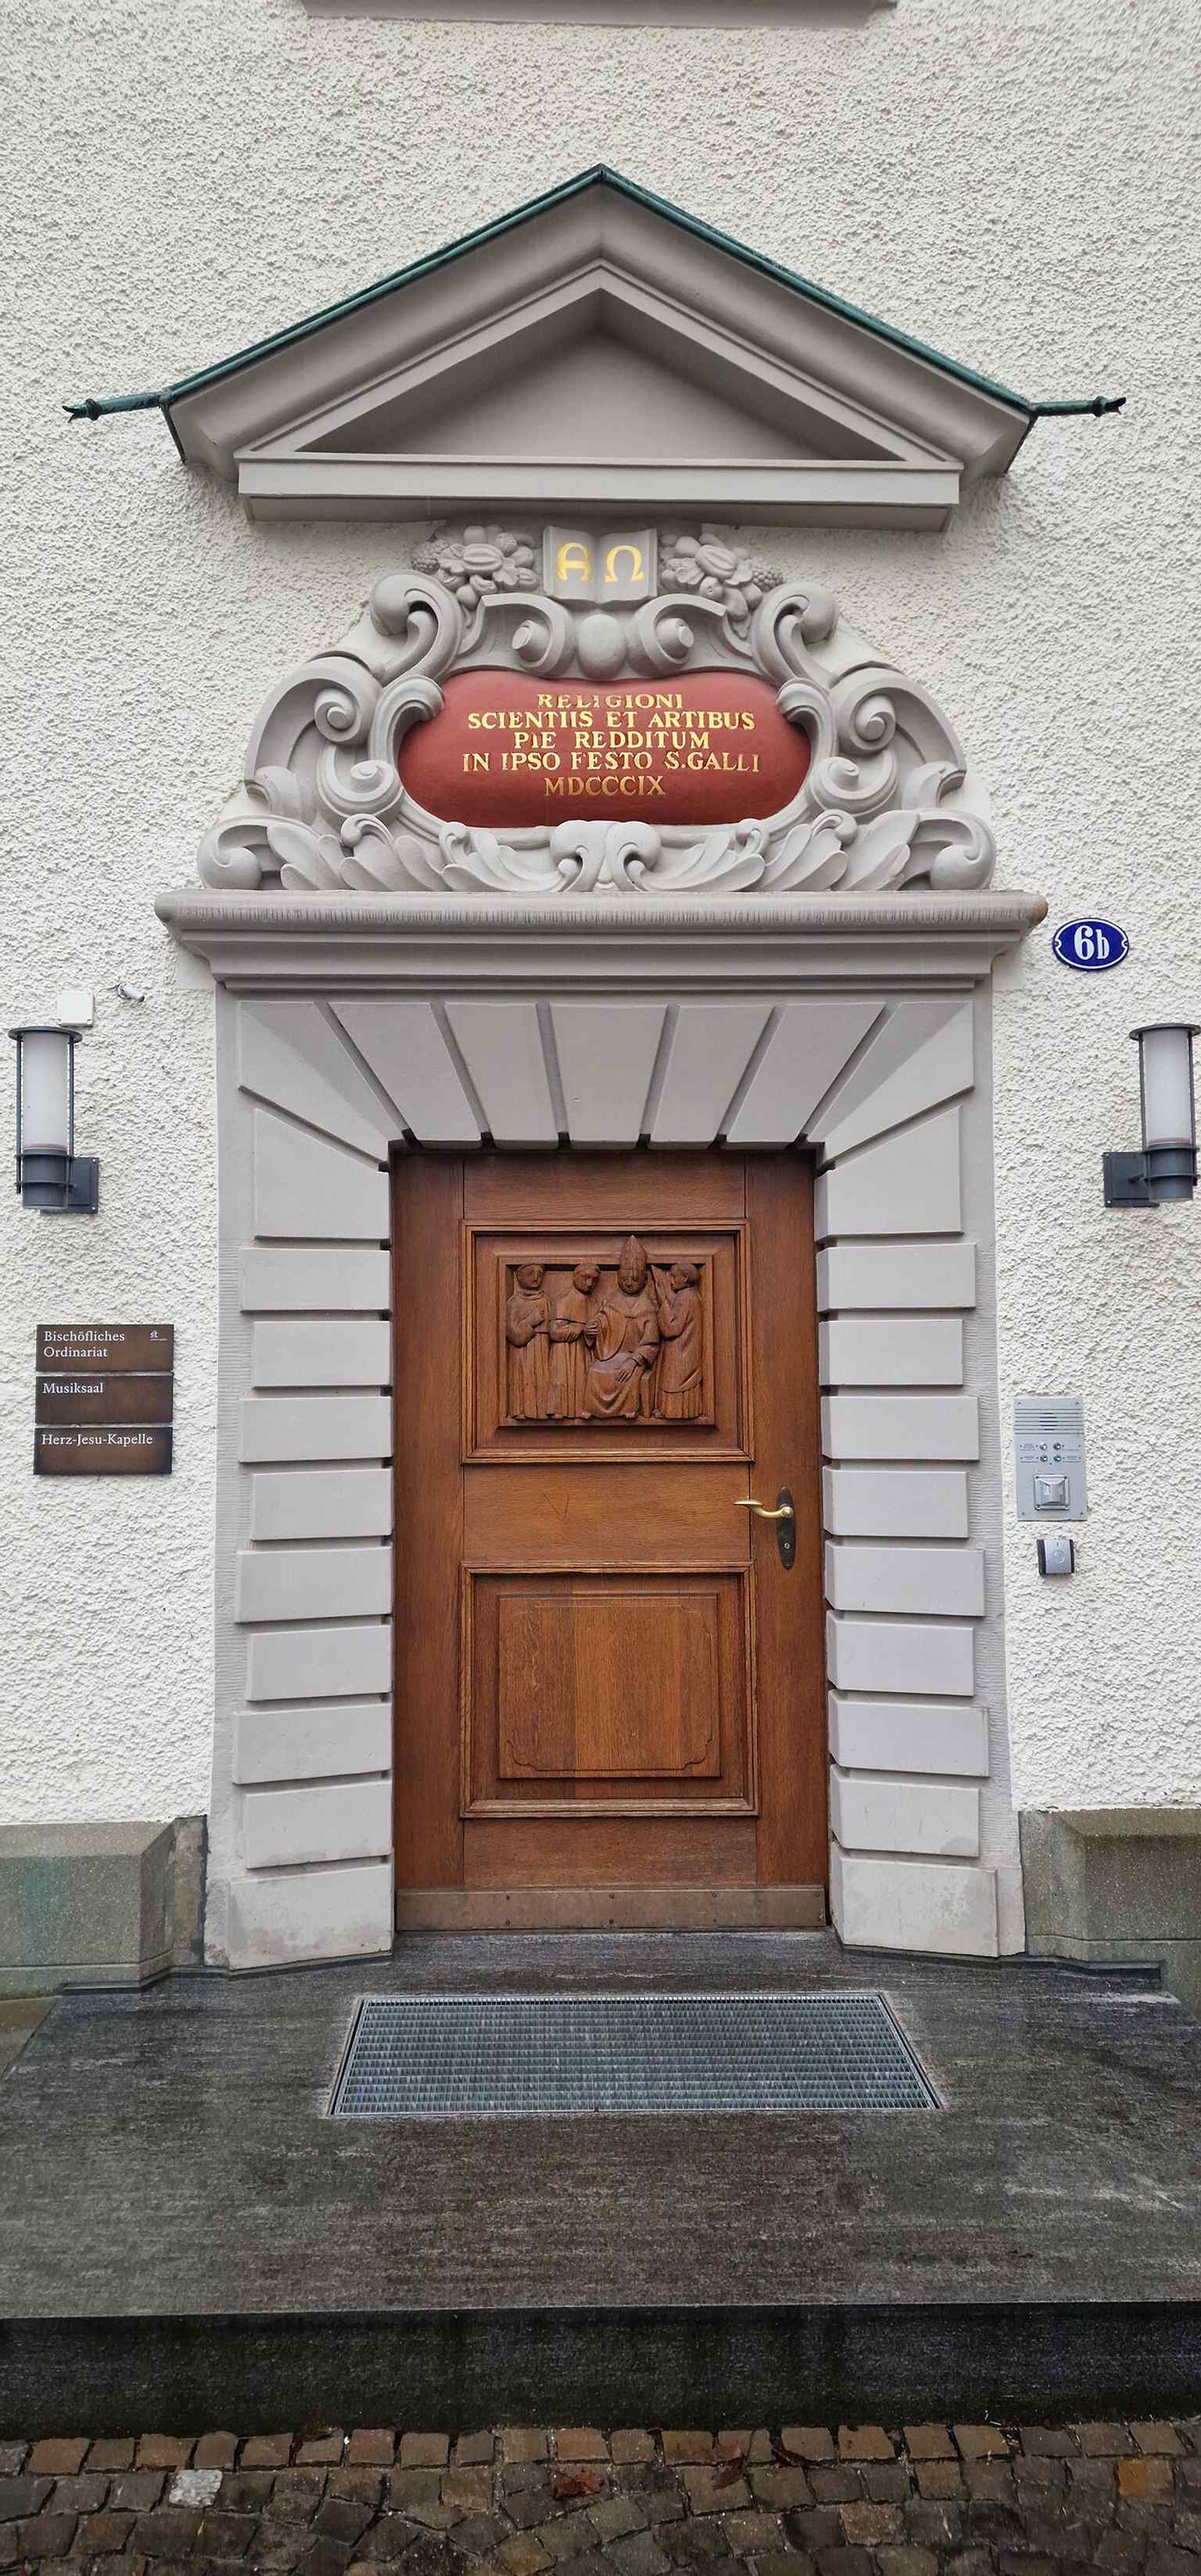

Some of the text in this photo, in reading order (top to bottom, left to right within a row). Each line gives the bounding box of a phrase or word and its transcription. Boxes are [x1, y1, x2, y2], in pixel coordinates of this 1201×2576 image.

[537, 694, 683, 709] RELIGIONI
[468, 711, 755, 730] SCIENTIIS ET ARTIBUS
[514, 730, 710, 749] PIE REDDITUM
[463, 752, 489, 772] IN
[501, 752, 561, 771] IPSO
[571, 751, 652, 770] FESTO
[544, 776, 665, 796] MDCCCIX
[1074, 925, 1110, 960] 6b
[44, 1330, 125, 1342] Bischöfliches
[43, 1346, 108, 1358] Ordinariat
[42, 1383, 104, 1394] Musiksaal
[41, 1433, 153, 1447] Herz-Jesu-Kapelle
